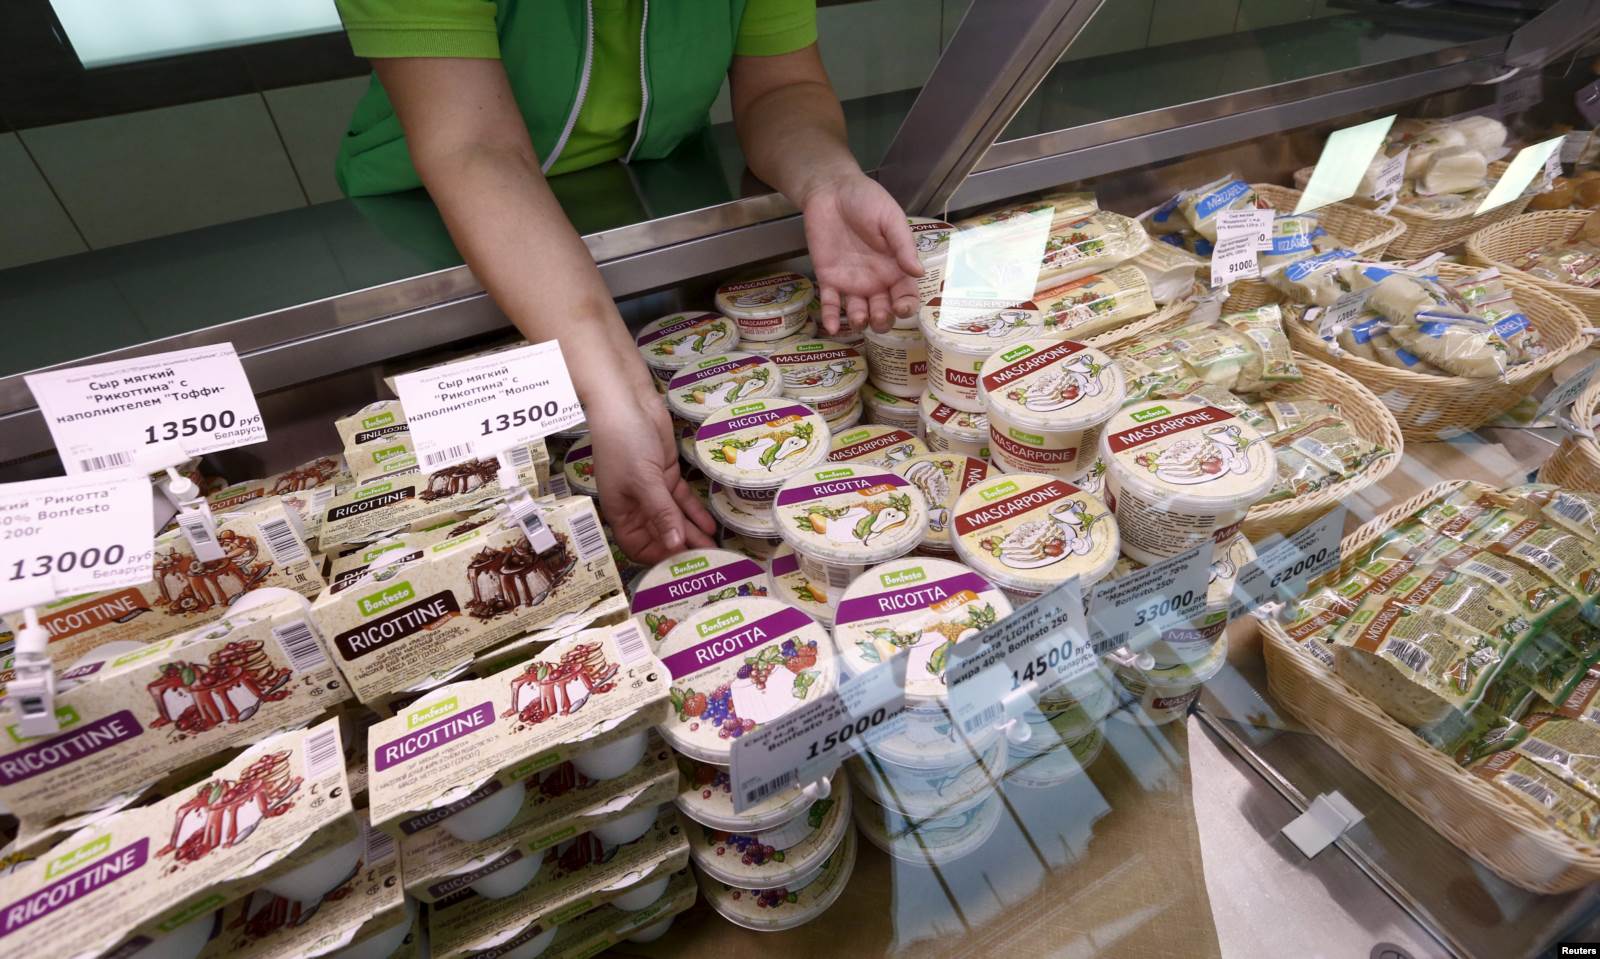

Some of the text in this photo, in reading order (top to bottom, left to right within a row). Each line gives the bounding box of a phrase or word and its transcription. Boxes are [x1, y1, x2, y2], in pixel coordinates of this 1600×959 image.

[1228, 259, 1255, 274] 91000
[659, 318, 698, 337] RICOTTA
[695, 360, 741, 380] RICOTTA
[775, 350, 848, 365] MASCARPONE
[992, 344, 1072, 385] MASCARPONE
[88, 378, 121, 396] Сыр
[123, 366, 177, 387] мягкий
[437, 382, 464, 395] Сыр
[465, 366, 510, 386] мягкий
[56, 397, 163, 425] наполнителем
[407, 394, 497, 424] наполнителем
[480, 400, 560, 438] 13500
[727, 410, 782, 432] RICOTTA
[145, 409, 237, 446] 13500
[1118, 410, 1214, 447] MASCARPONE
[827, 433, 899, 462] MASCARPONE
[991, 430, 1072, 463] MASCARPONE
[209, 491, 260, 512] COTTINE
[812, 477, 872, 498] RICOTTA
[37, 502, 112, 523] Bonfesto
[335, 489, 409, 519] RICOTTINE
[965, 485, 1061, 528] MASCARPONE
[9, 543, 125, 582] 13000
[672, 558, 708, 577] Bonfesto
[882, 568, 925, 586] Bonfesto
[1269, 547, 1328, 589] 62000
[363, 586, 411, 613] Bonfesto
[667, 571, 727, 598] RICOTTA
[877, 586, 949, 613] RICOTTA
[1096, 585, 1118, 600] Сыр
[940, 592, 968, 612] LIGHT
[1134, 590, 1194, 628] 33000
[346, 598, 450, 655] RICOTTINE
[699, 613, 741, 636] Bonfesto
[981, 605, 1040, 645] Сыр мягкий
[695, 625, 768, 665] RICOTTA
[982, 652, 1007, 670] 40%
[1008, 625, 1051, 656] Bonfesto
[1051, 613, 1069, 631] 250
[1010, 640, 1073, 692] 14500
[410, 700, 456, 727] Bonfesto
[384, 710, 487, 765] RICOTTINE
[767, 719, 824, 752] Bonfesto
[804, 706, 887, 761] 15000
[2, 717, 130, 782] RICOTTINE
[408, 784, 493, 831] RICOTTINE
[5, 845, 138, 929] RICOTTINE
